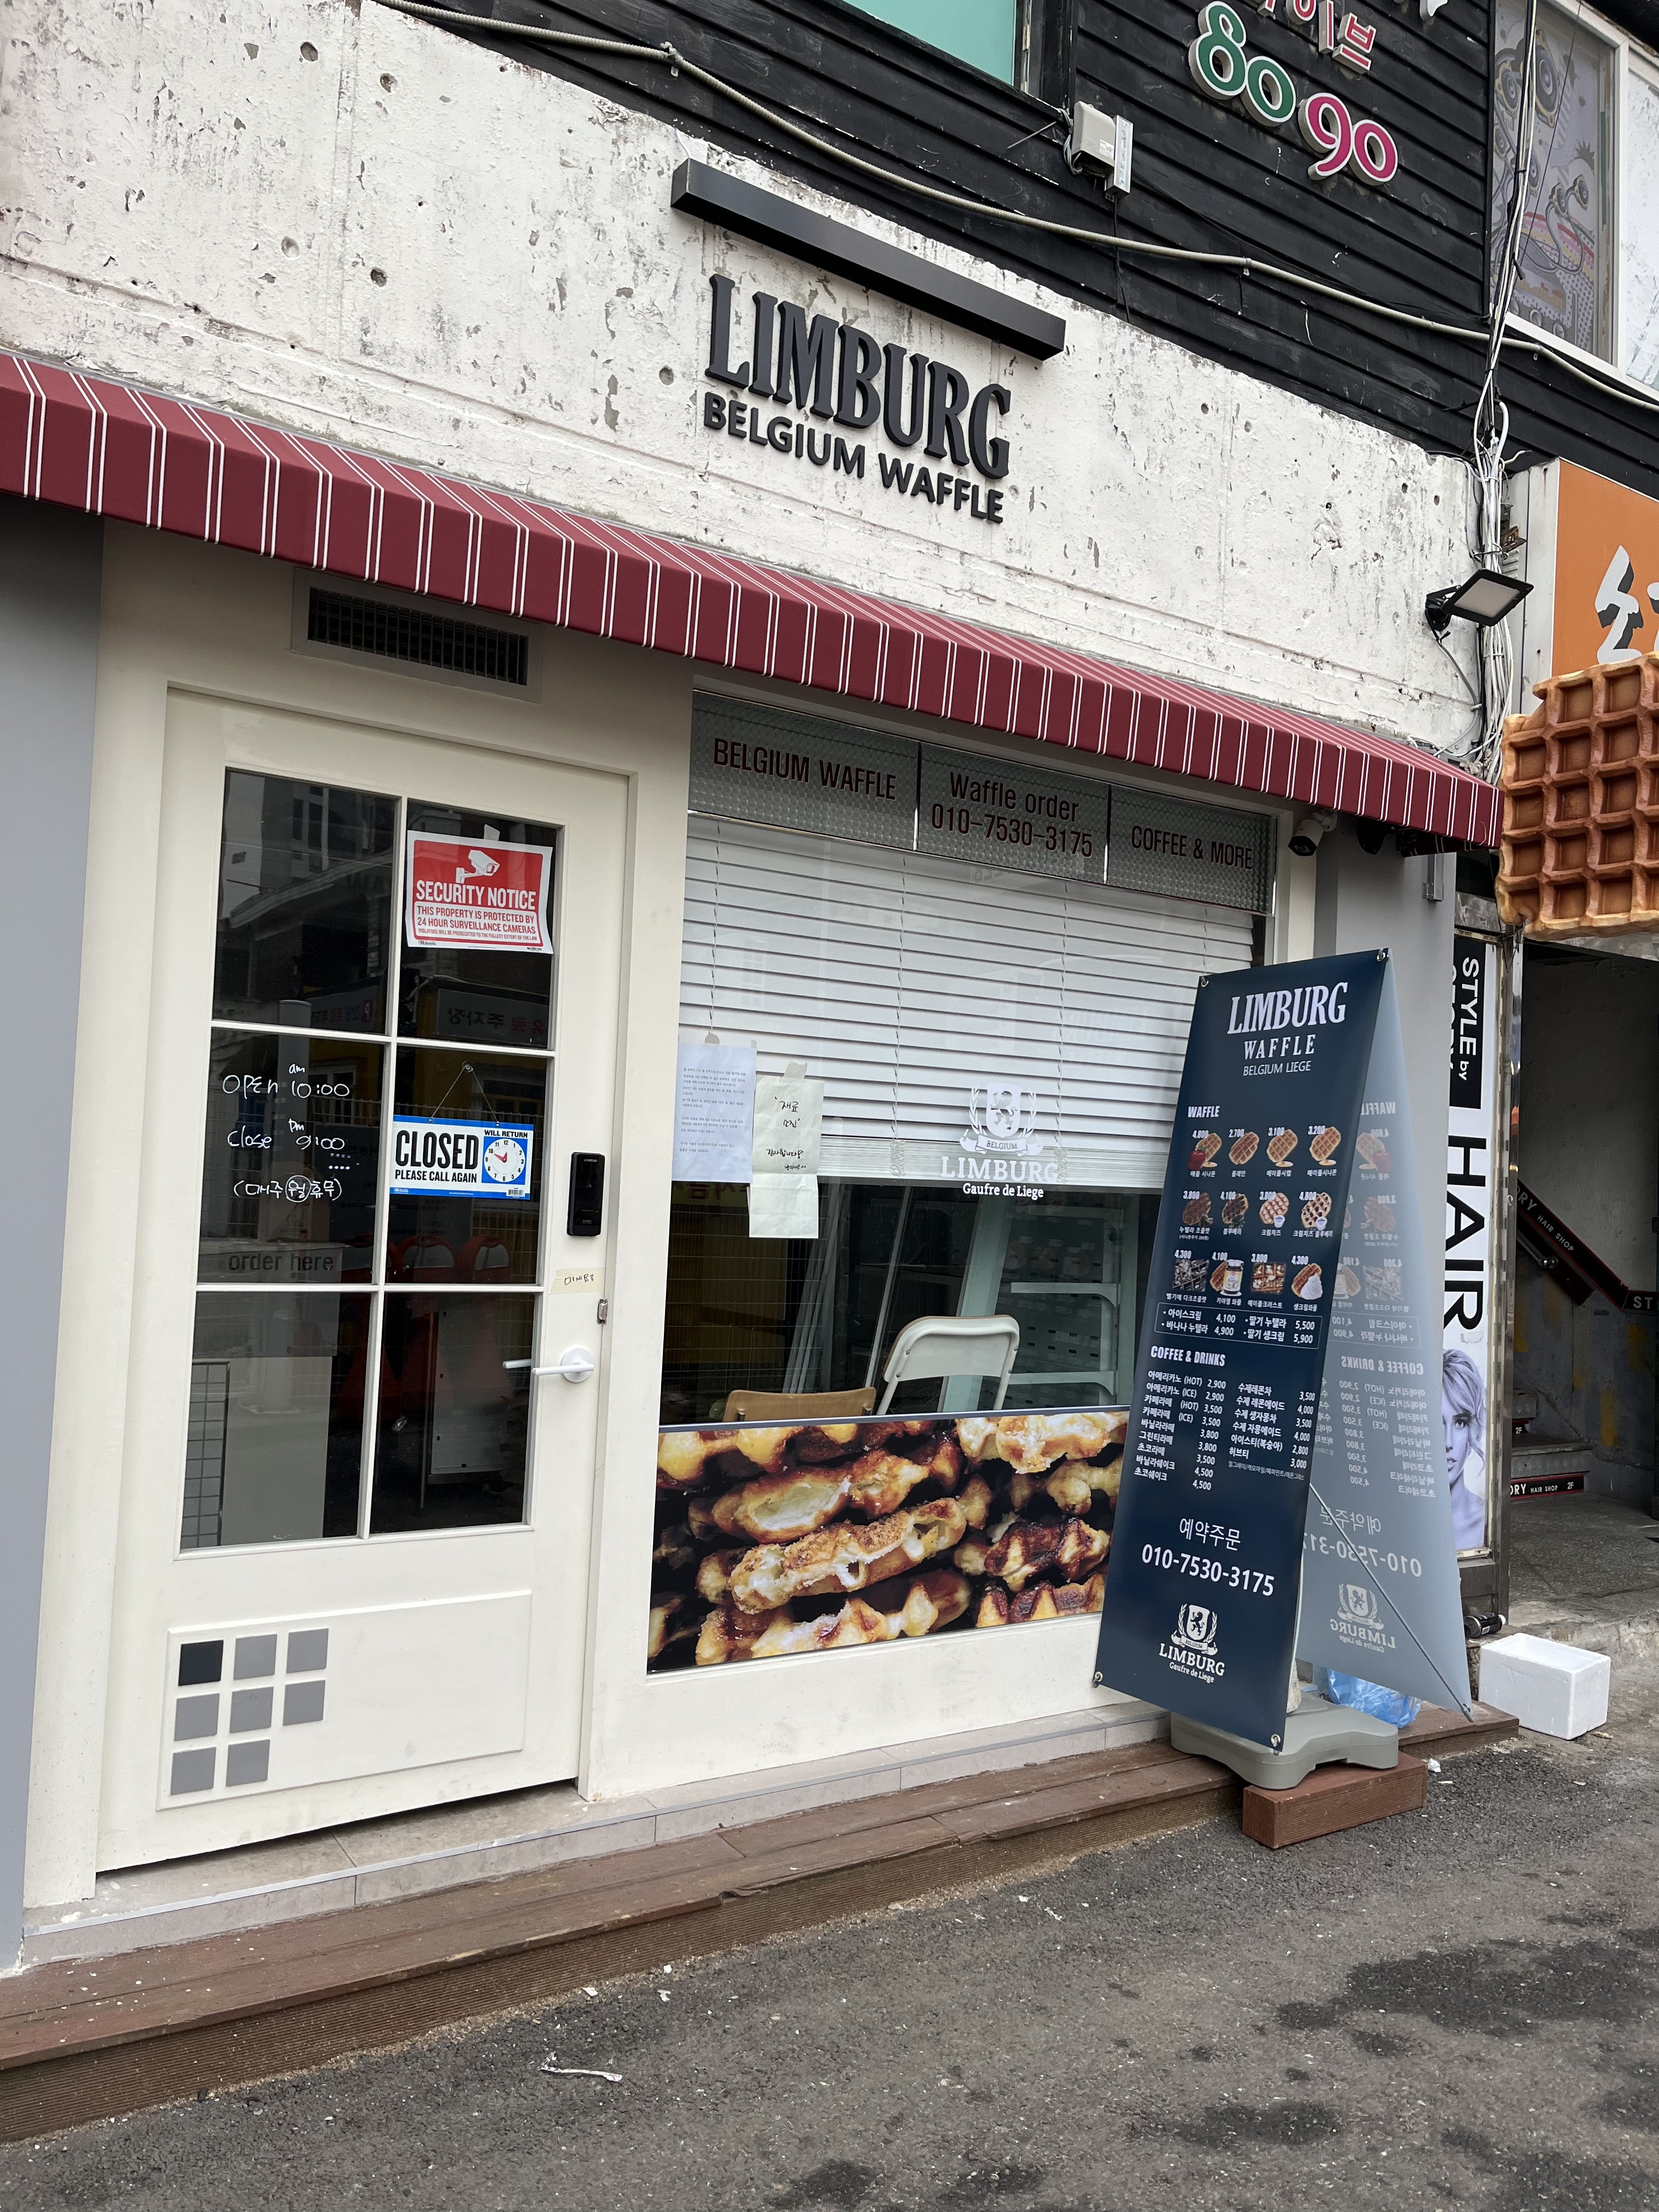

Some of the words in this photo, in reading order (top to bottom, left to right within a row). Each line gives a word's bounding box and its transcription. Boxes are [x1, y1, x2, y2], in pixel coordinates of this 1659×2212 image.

[705, 274, 1011, 479] LIMBURG
[704, 392, 866, 478] BELGIUM
[878, 453, 1003, 523] WAFFLE
[713, 738, 810, 784] BELGIUM
[819, 759, 897, 801] WAFFLE
[949, 772, 1016, 811] Waffle
[1024, 789, 1080, 823] order
[930, 803, 1093, 859] 010-7530-3175
[1130, 825, 1188, 857] COFFEE
[1192, 838, 1204, 861] &
[1209, 841, 1254, 871] MORE
[416, 880, 485, 905] SECURITY
[488, 887, 536, 910] NOTICE
[417, 905, 434, 916] THIS
[436, 907, 473, 919] PROPERTY
[475, 911, 481, 919] IS
[483, 911, 523, 923] PROTECTED
[526, 915, 534, 924] BY
[417, 917, 426, 926] 24
[428, 918, 448, 928] HOUR
[450, 919, 501, 932] SURVEILLANCE
[503, 923, 536, 934] CAMERAS
[1227, 981, 1348, 1035] LIMBURG
[1459, 957, 1480, 1056] STYLE
[1244, 1034, 1316, 1060] WAFFLE
[1243, 1063, 1283, 1076] BELGIUM
[1285, 1060, 1312, 1073] LIEGE
[1459, 1060, 1469, 1081] by
[1188, 1105, 1220, 1118] WAFFLE
[396, 1130, 479, 1170] CLOSED
[986, 1140, 1018, 1149] BELGIUM
[395, 1170, 427, 1181] PLEASE
[429, 1171, 449, 1182] CALL
[452, 1172, 477, 1183] AGAIN
[941, 1156, 1059, 1183] LIMBURG
[963, 1182, 1000, 1195] Gaufre
[1002, 1184, 1015, 1196] de
[1017, 1185, 1044, 1200] Liege
[1443, 1135, 1486, 1329] HAIR
[1537, 1215, 1554, 1233] HAIR
[1555, 1233, 1574, 1252] SHOP
[229, 1253, 283, 1271] order
[290, 1253, 334, 1271] here
[1150, 1345, 1184, 1362] COFFEE
[1185, 1351, 1191, 1362] &
[1194, 1351, 1226, 1367] DRINKS
[1148, 1370, 1182, 1383] 아메리카노
[1184, 1375, 1203, 1386] (HOT)
[1207, 1379, 1226, 1389] 2,900
[1146, 1383, 1180, 1395] 아메리카노
[1182, 1388, 1197, 1398] (ICE)
[1205, 1391, 1224, 1402] 2,900
[1299, 1391, 1316, 1402] 3,500
[1144, 1395, 1172, 1407] 카페라떼
[1180, 1400, 1199, 1411] (HOT)
[1203, 1404, 1223, 1414] 3,500
[1236, 1396, 1250, 1407] 수제
[1251, 1398, 1285, 1411] 레몬에이드
[1297, 1404, 1314, 1415] 4,000
[1142, 1406, 1171, 1419] 카페라떼
[1178, 1412, 1194, 1423] (ICE)
[1201, 1417, 1221, 1426] 3,500
[1234, 1408, 1249, 1420] 수제
[1295, 1418, 1312, 1429] 3,500
[1141, 1418, 1175, 1433] 바닐라라떼
[1200, 1429, 1219, 1440] 3,800
[1232, 1421, 1247, 1432] 수제
[1294, 1431, 1310, 1442] 4,000
[1138, 1431, 1173, 1445] 그린티라떼
[1198, 1441, 1217, 1452] 3,800
[1292, 1444, 1308, 1455] 2,800
[1137, 1442, 1165, 1456] 초코라떼
[1196, 1454, 1215, 1465] 3,500
[1229, 1447, 1249, 1459] 허브티
[1290, 1458, 1307, 1469] 3,000
[1194, 1467, 1214, 1478] 4,500
[1192, 1480, 1211, 1491] 4,500
[1180, 1518, 1241, 1551] 예약주문
[1142, 1544, 1275, 1596] 010-7530-3175
[1159, 1643, 1226, 1676] LIMBURG
[1169, 1662, 1189, 1675] Gaufre
[1190, 1668, 1198, 1678] de
[1198, 1671, 1215, 1684] Liege
